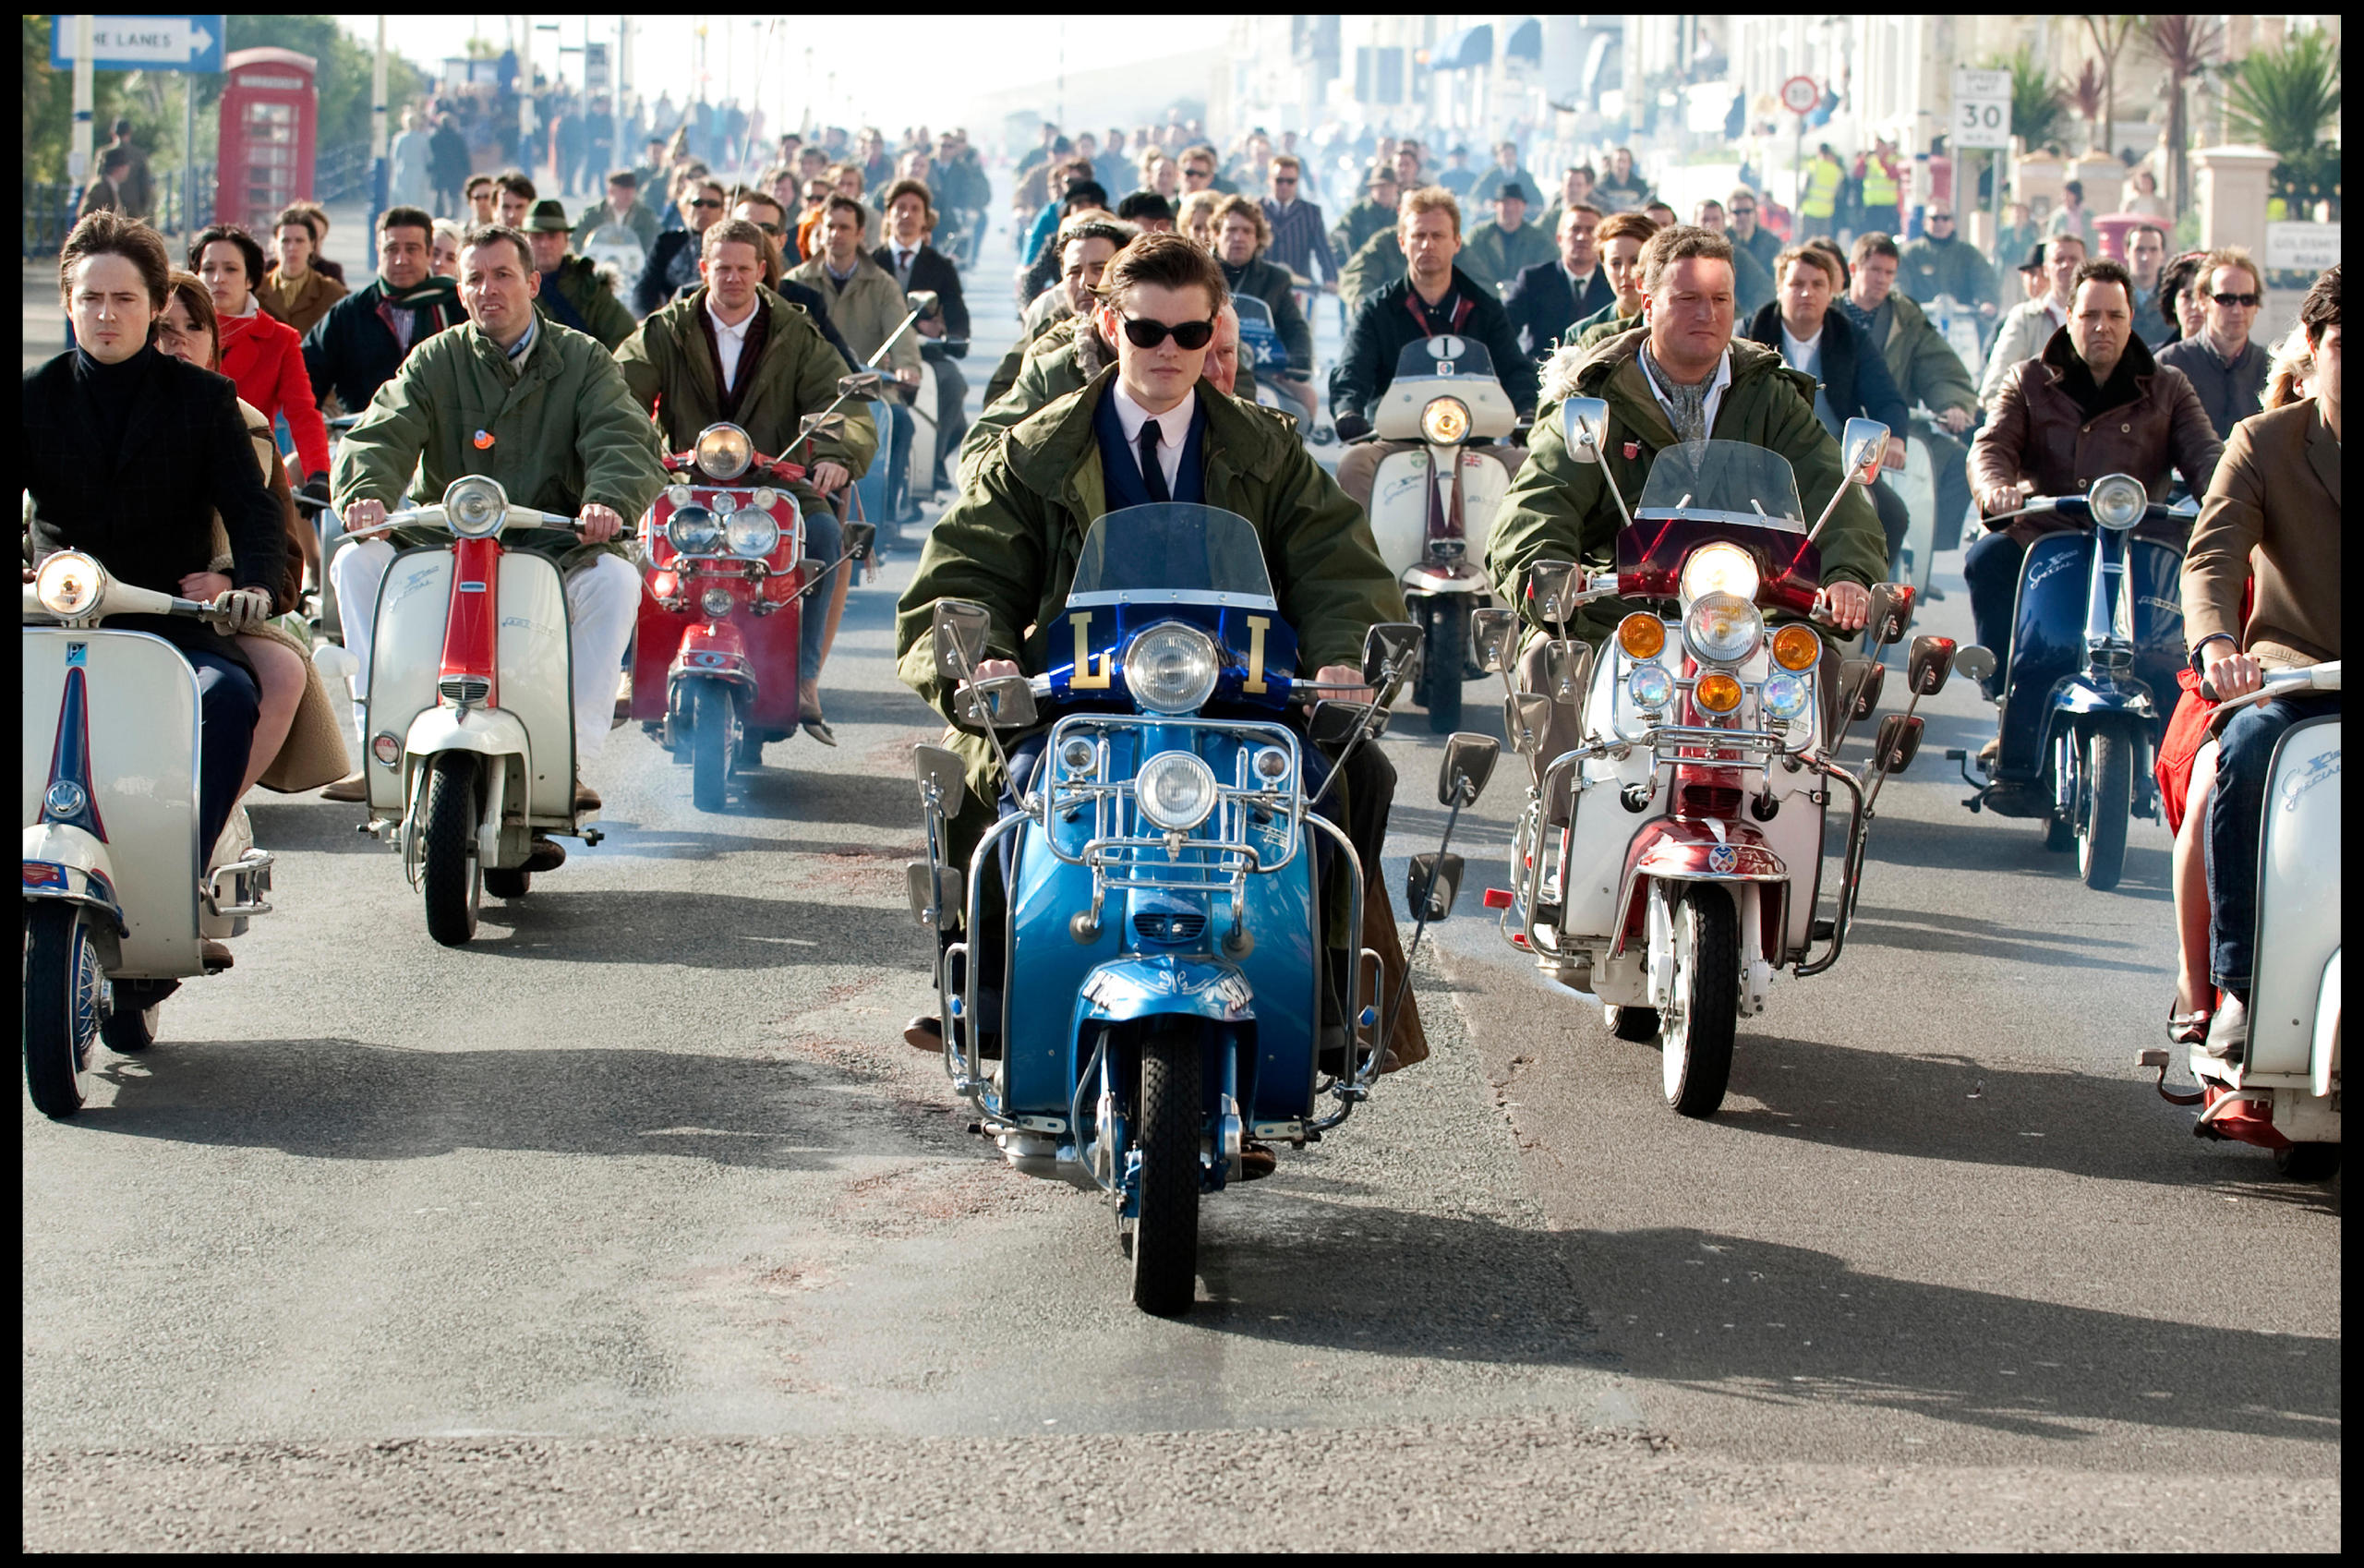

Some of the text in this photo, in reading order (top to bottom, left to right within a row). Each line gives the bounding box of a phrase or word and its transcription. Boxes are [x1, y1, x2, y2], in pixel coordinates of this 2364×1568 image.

[117, 33, 172, 47] LANES
[1962, 103, 2002, 128] 30
[69, 644, 79, 658] P
[1069, 611, 1271, 694] L I
